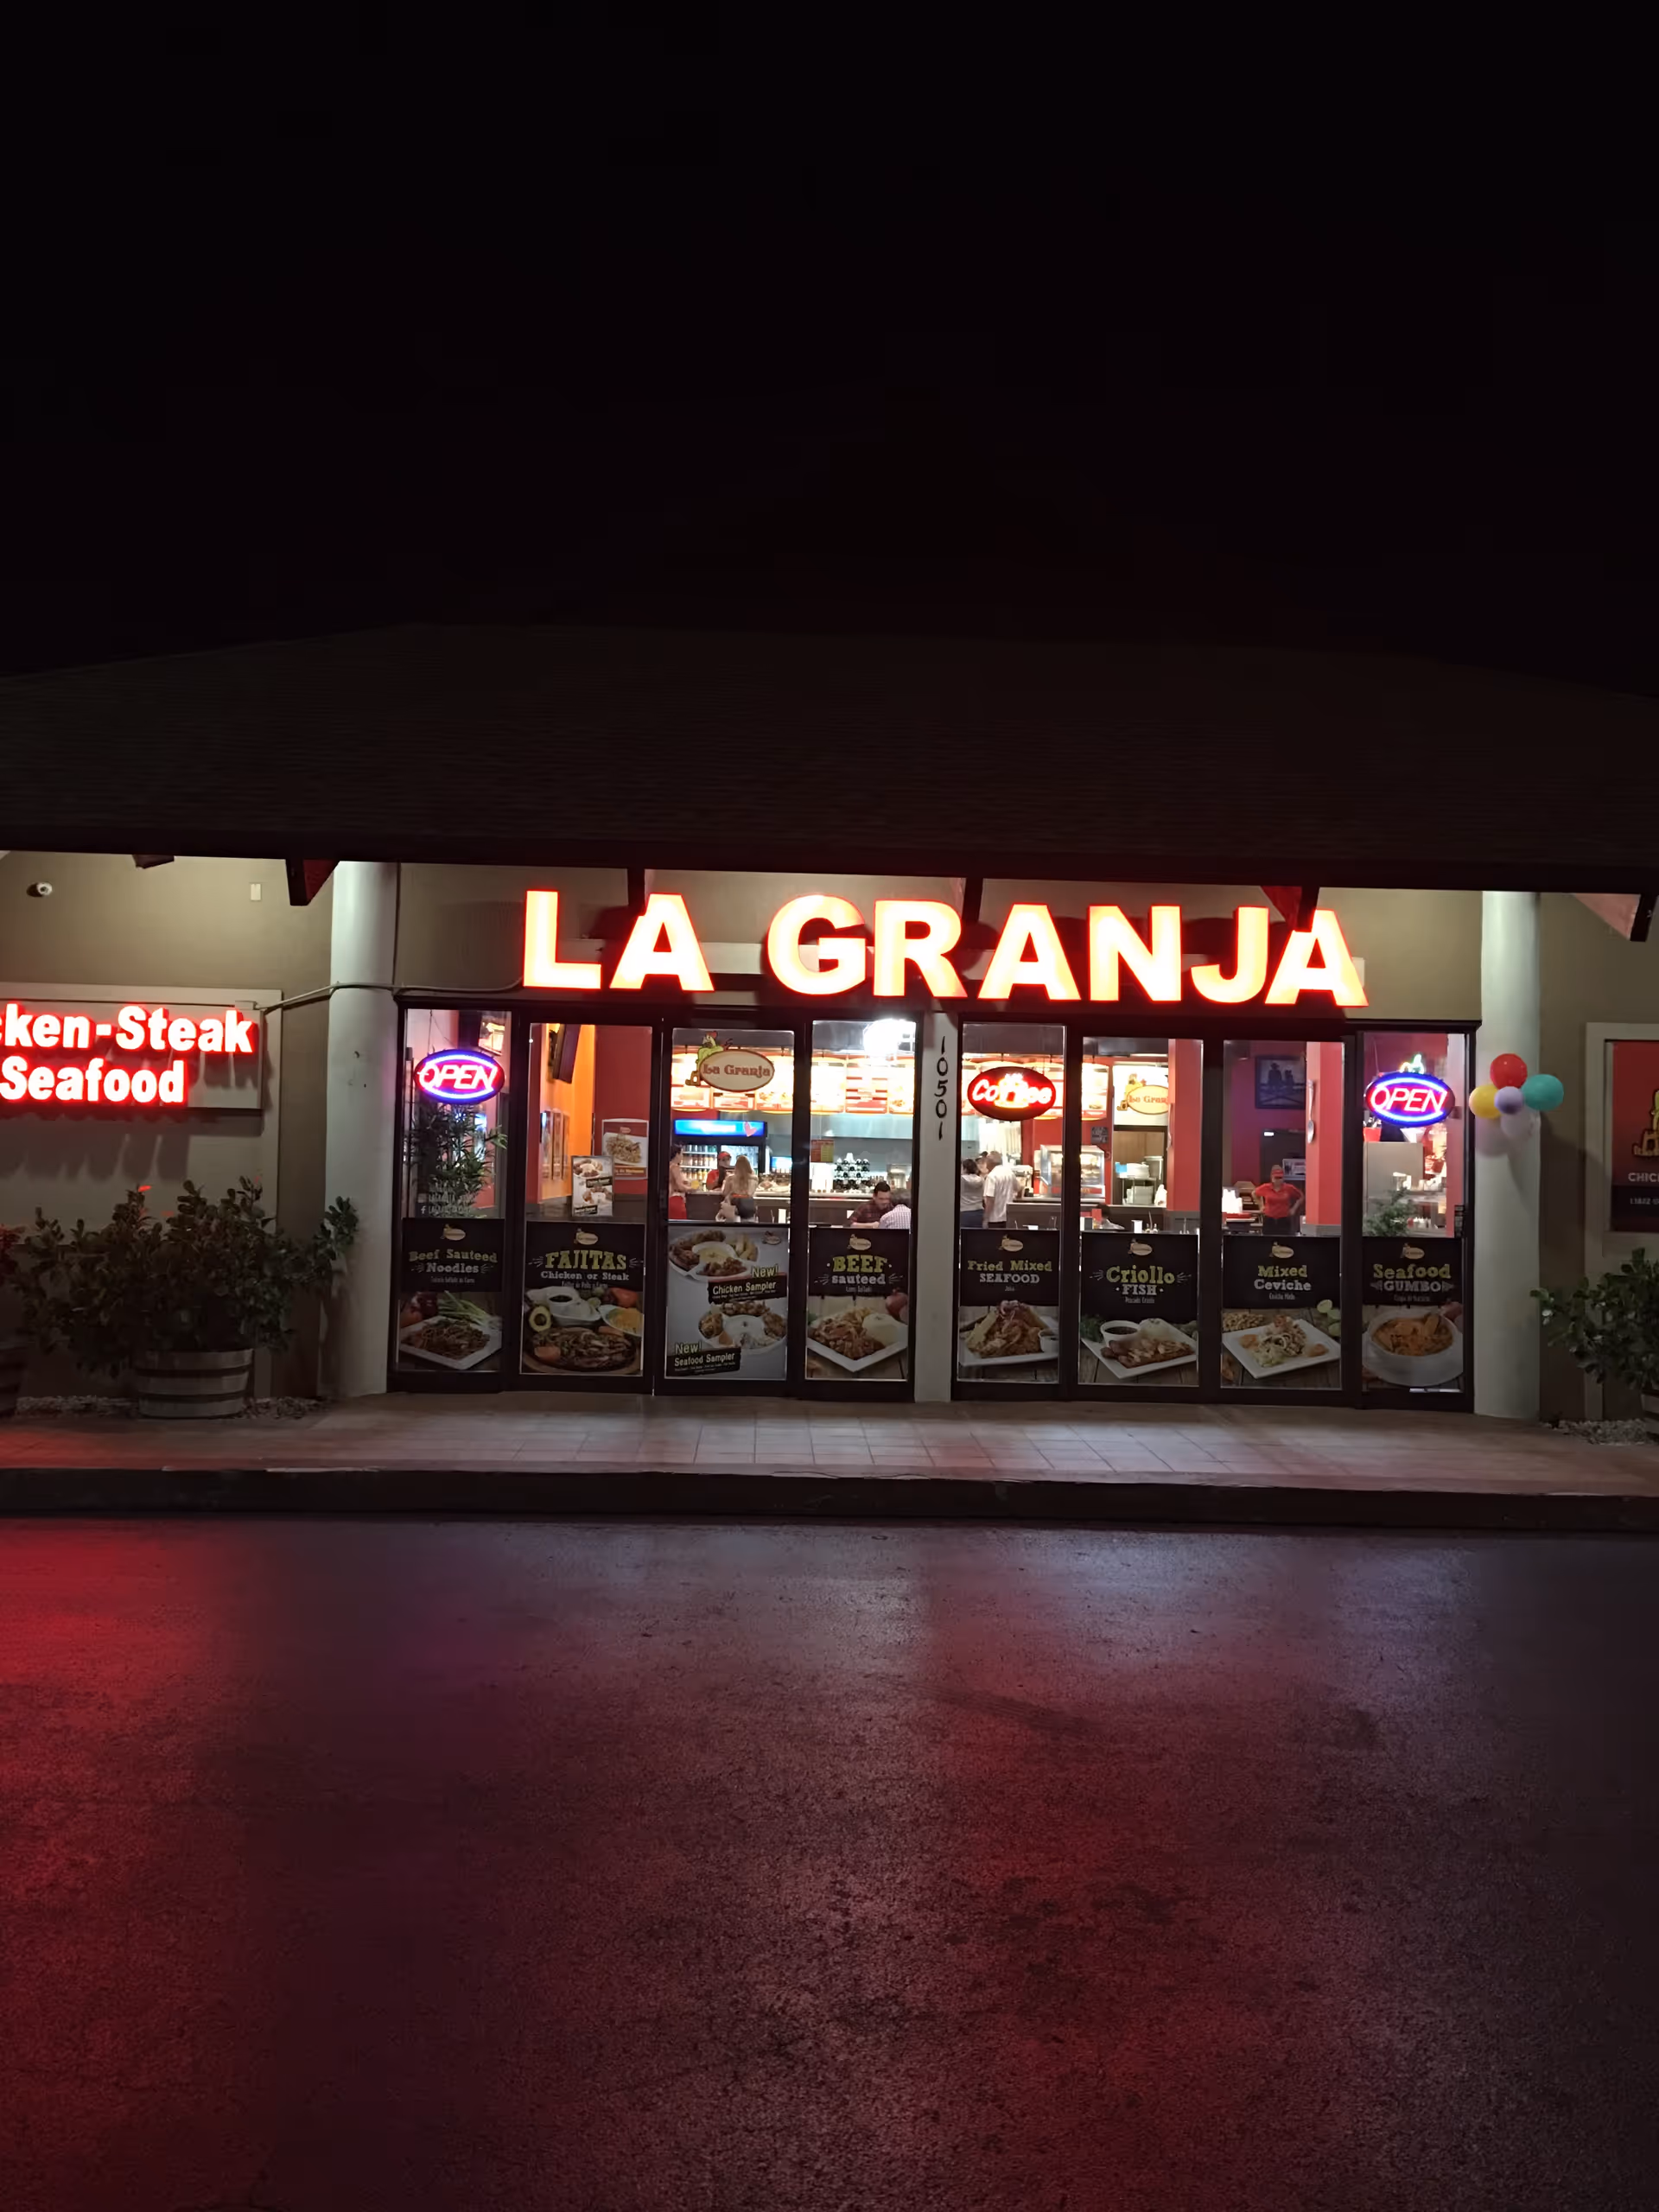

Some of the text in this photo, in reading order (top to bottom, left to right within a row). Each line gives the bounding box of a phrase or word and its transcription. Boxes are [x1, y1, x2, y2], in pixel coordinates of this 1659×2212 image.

[523, 889, 1370, 1007] LA GRANJA
[0, 1002, 253, 1053] ken-Steak
[702, 1063, 772, 1077] La Granja
[1, 1055, 185, 1103] Seafood
[418, 1064, 499, 1091] OPEN
[934, 1036, 949, 1141] 10501
[1143, 1095, 1169, 1105] Gran
[1370, 1085, 1448, 1113] OPEN
[409, 1249, 498, 1263] Beef Sauteed
[544, 1249, 627, 1271] FAJITAS
[426, 1262, 480, 1273] Noodles
[832, 1254, 888, 1273] BEEF
[967, 1260, 1052, 1272] Fried Mixed
[540, 1270, 582, 1281] Chicken
[602, 1272, 630, 1281] Steak
[752, 1264, 779, 1279] New!
[979, 1273, 1040, 1284] SEAFOOD
[1106, 1264, 1175, 1284] Criollo
[1257, 1265, 1307, 1278] Mixed
[1373, 1263, 1452, 1280] Seafood
[831, 1274, 887, 1285] sauteed
[1254, 1279, 1312, 1291] Ceviche
[712, 1284, 743, 1295] Chicken
[745, 1281, 777, 1294] Sampler
[1122, 1284, 1158, 1296] FISH
[1383, 1281, 1442, 1293] GUMBO
[675, 1340, 702, 1355] New!
[674, 1352, 735, 1367] Seafood Sampler
